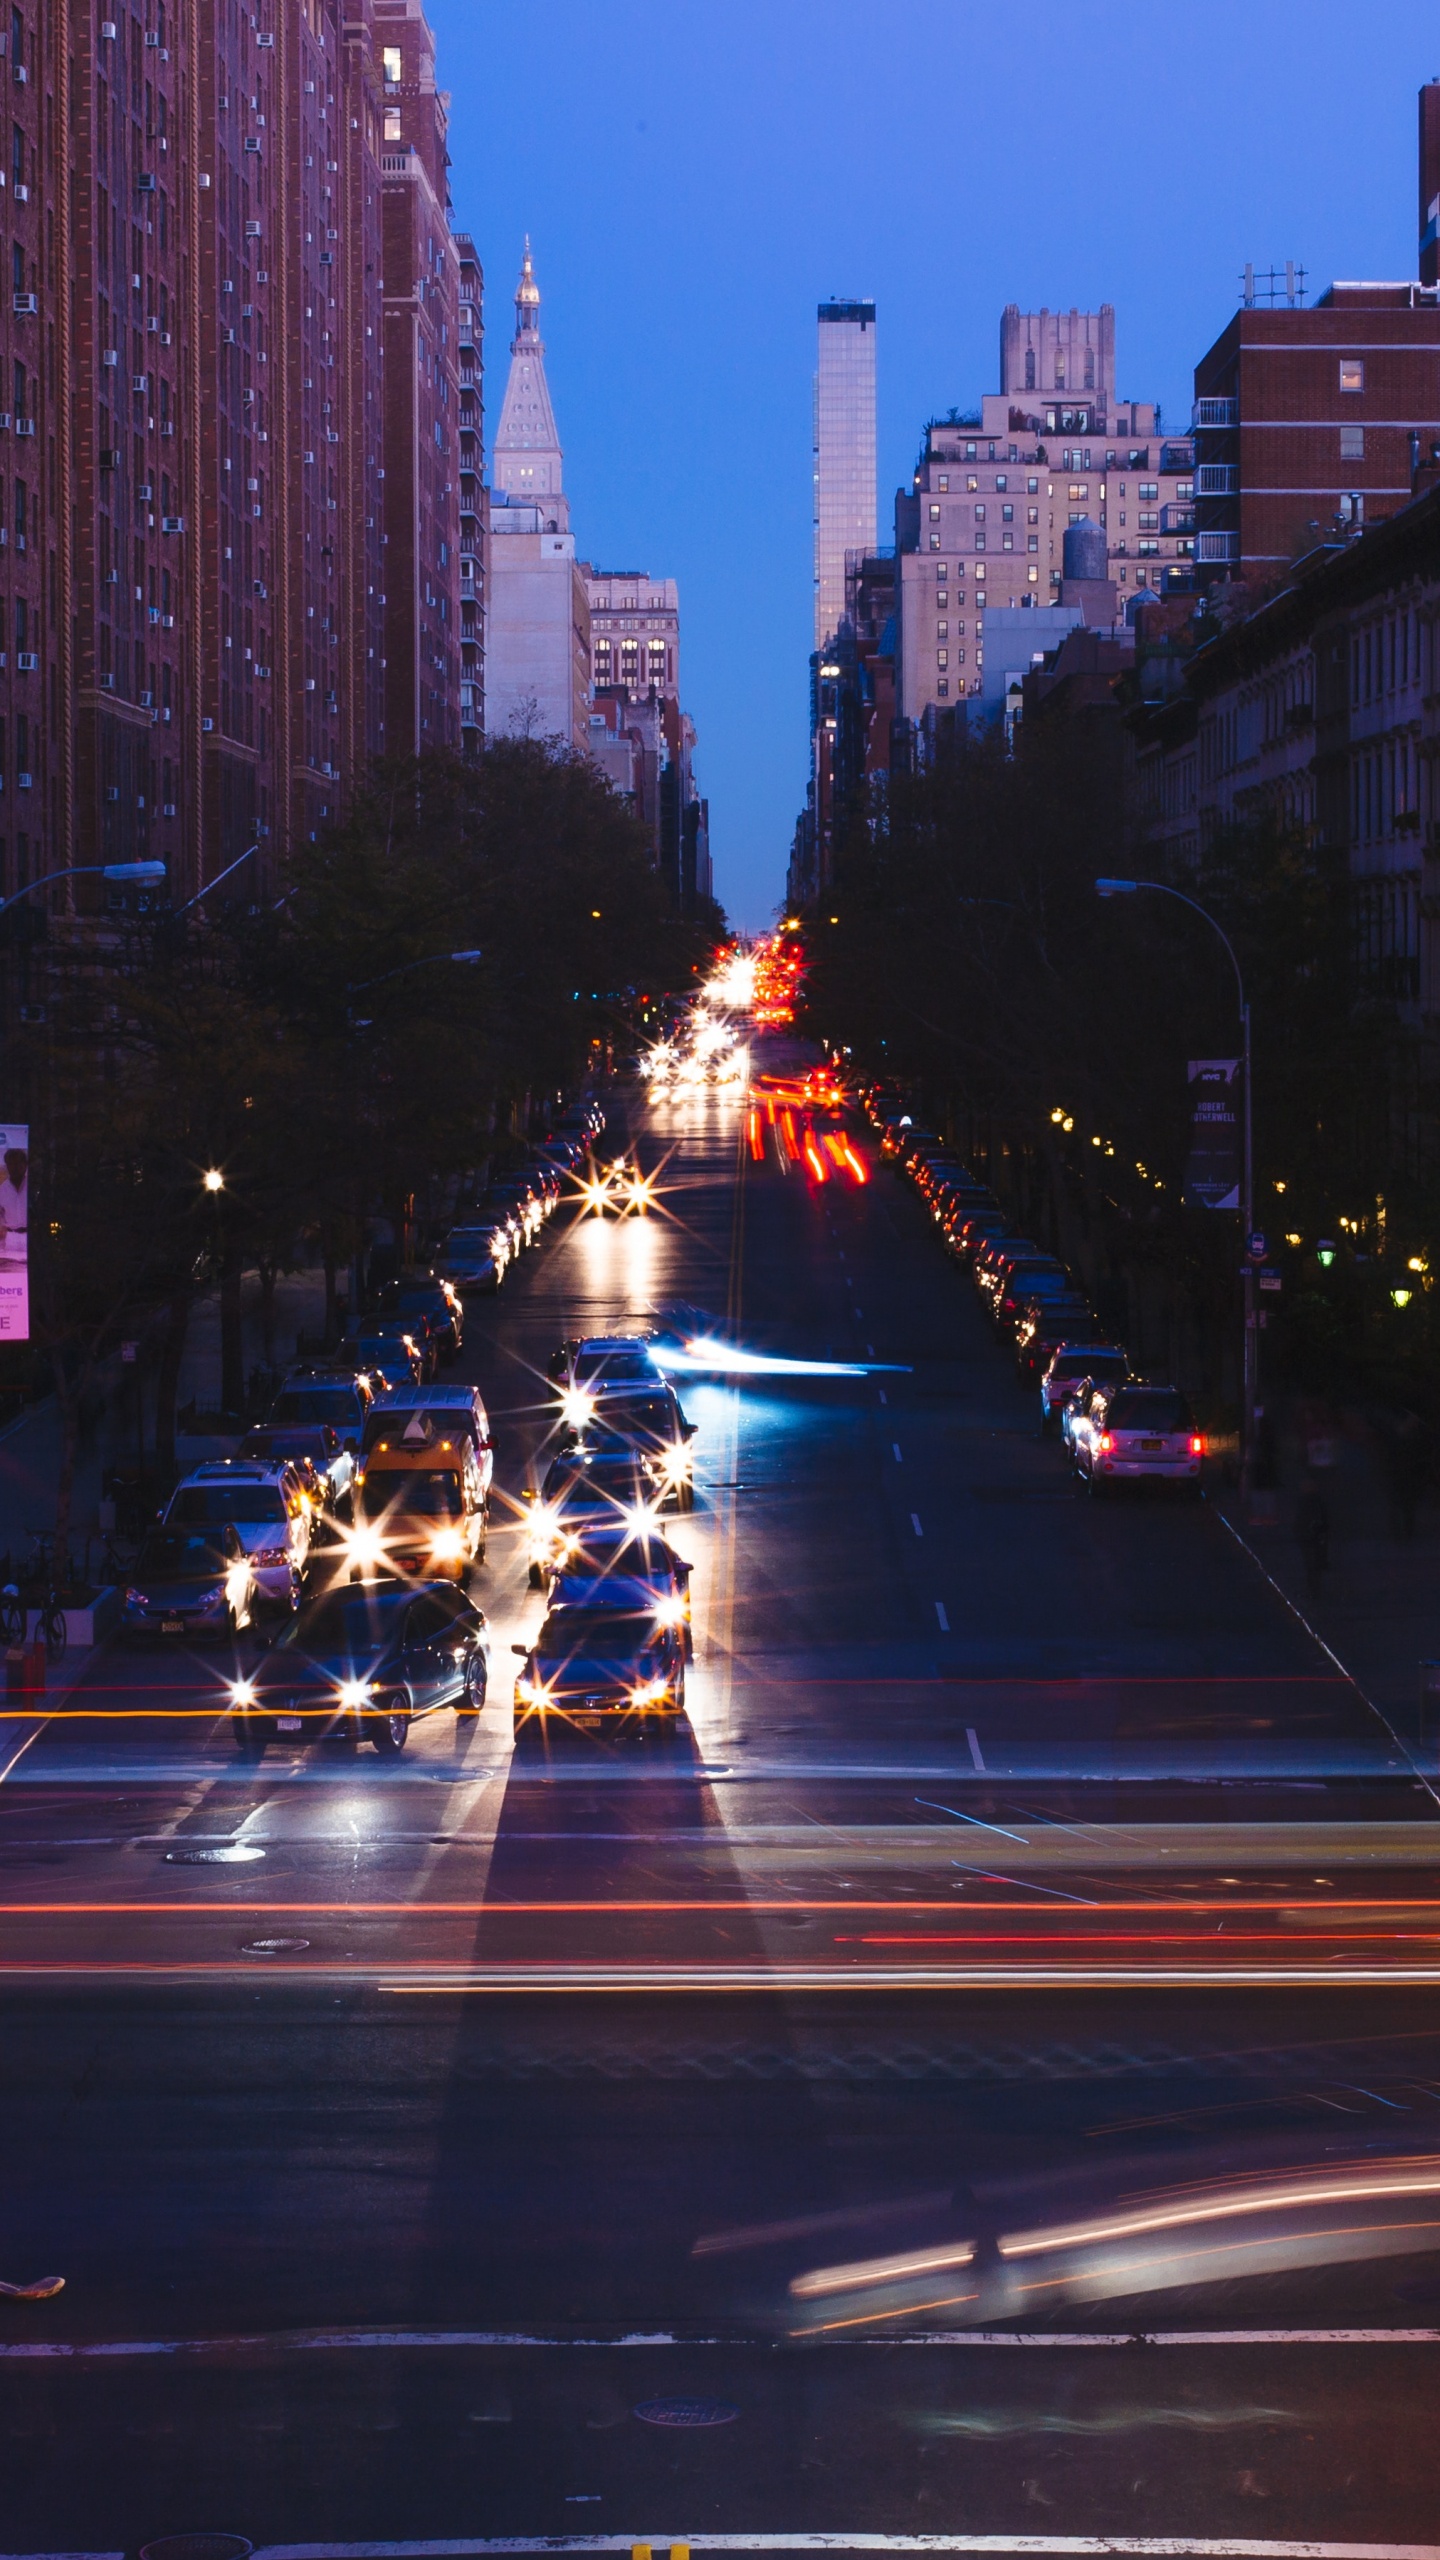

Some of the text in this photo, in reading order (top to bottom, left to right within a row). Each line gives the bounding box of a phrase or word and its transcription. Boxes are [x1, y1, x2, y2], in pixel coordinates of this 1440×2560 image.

[1202, 1073, 1221, 1081] NYC
[1197, 1102, 1226, 1112] ROBERT
[1191, 1112, 1236, 1122] OTHERWELL
